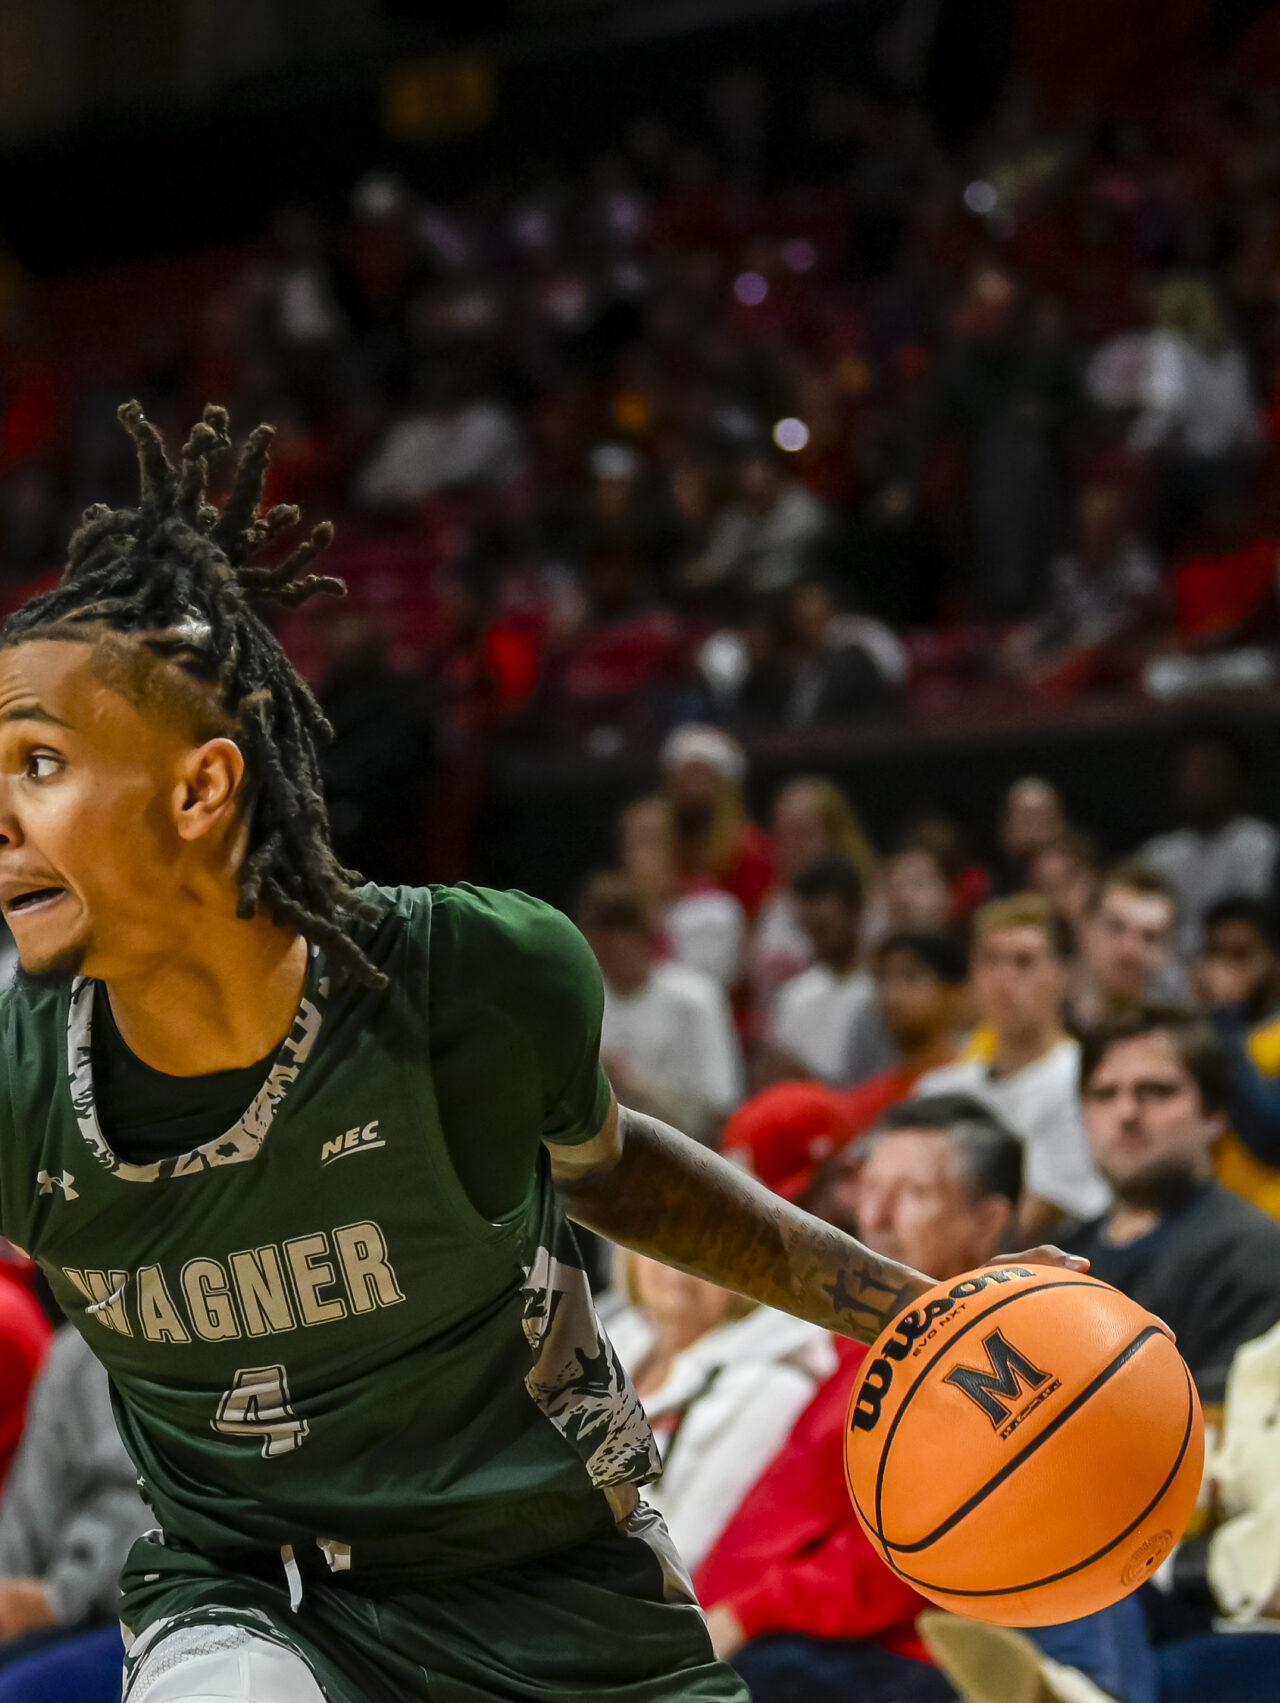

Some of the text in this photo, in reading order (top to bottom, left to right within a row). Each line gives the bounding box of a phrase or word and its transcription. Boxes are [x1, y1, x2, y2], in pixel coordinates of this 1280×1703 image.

[320, 1119, 382, 1162] NEC
[62, 1220, 406, 1344] WAGNER
[912, 1303, 967, 1358] EVO NXT
[851, 1267, 1037, 1432] Wilson
[943, 1326, 1054, 1432] M
[210, 1364, 310, 1459] 4
